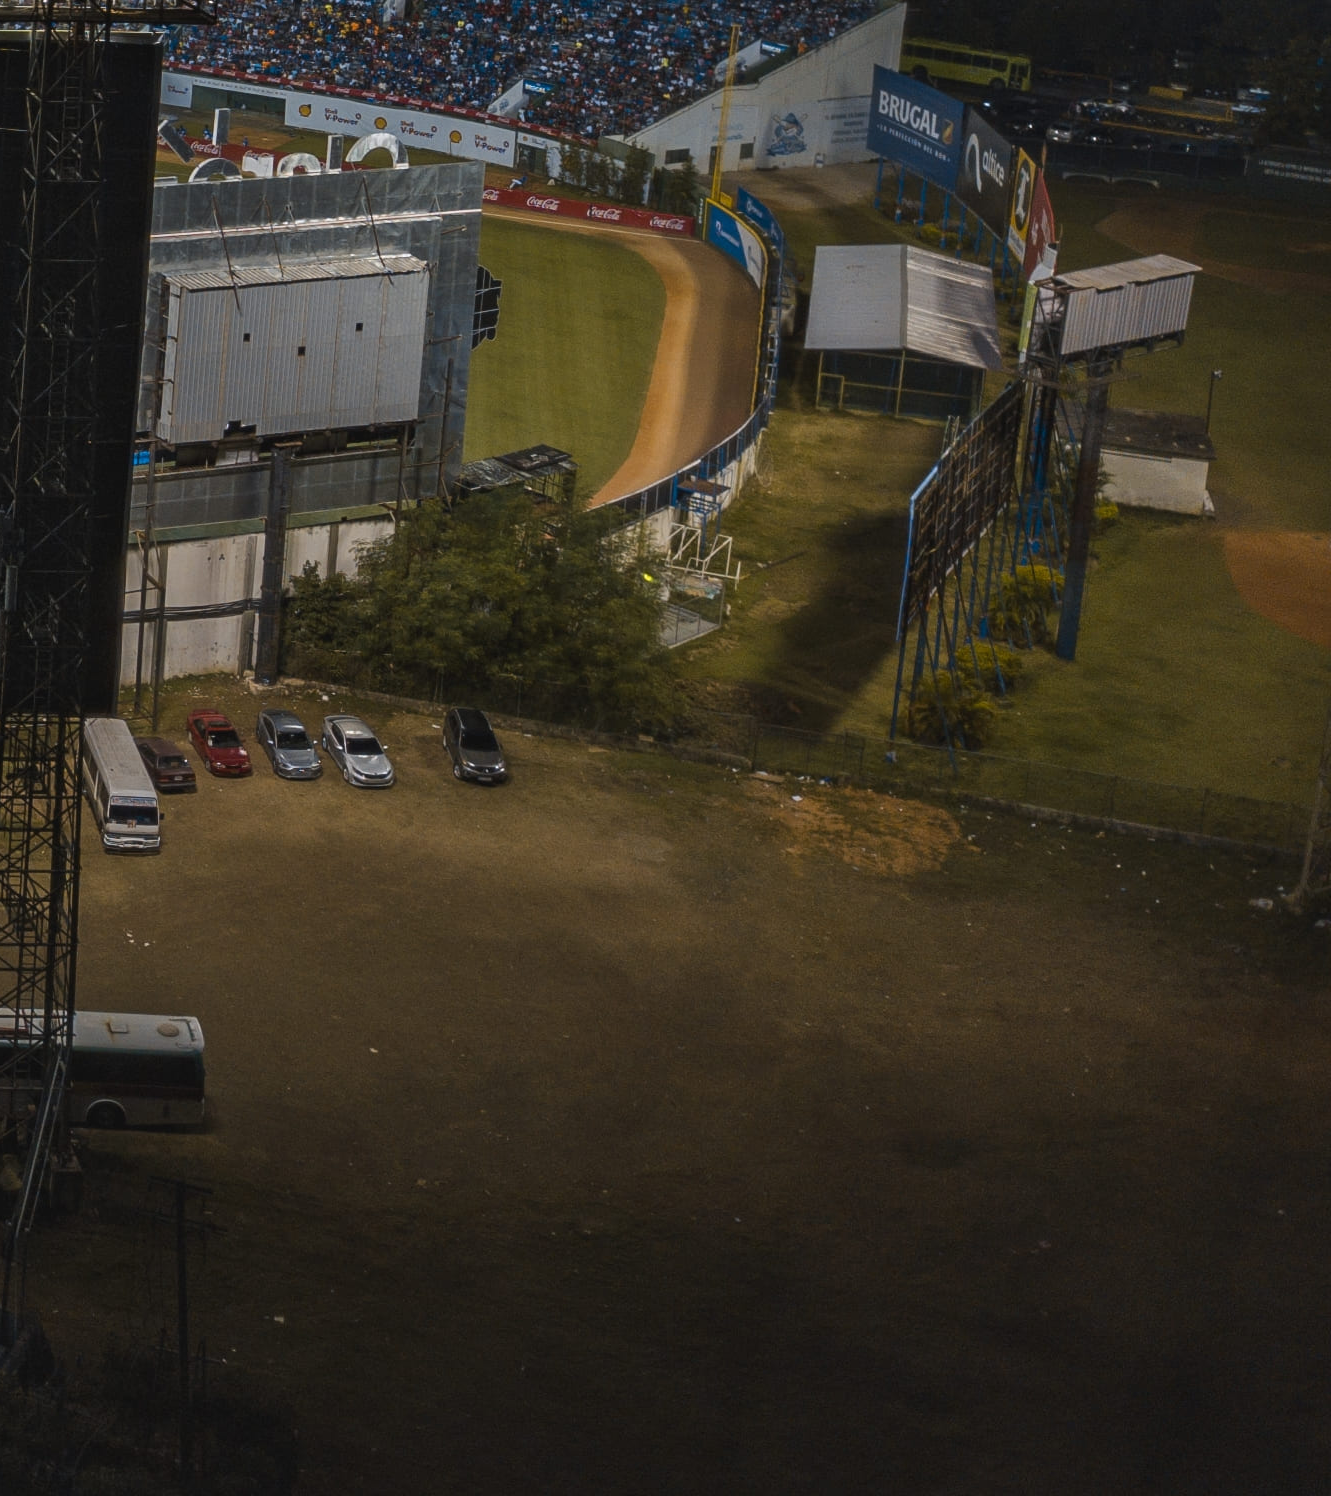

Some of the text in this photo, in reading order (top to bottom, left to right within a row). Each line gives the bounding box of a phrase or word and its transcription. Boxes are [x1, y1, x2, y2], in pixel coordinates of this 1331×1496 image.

[325, 113, 359, 125] V-Power
[879, 90, 939, 140] BRUGAL
[400, 126, 434, 139] V-Power
[474, 140, 507, 154] V-Power
[982, 149, 1005, 188] altice
